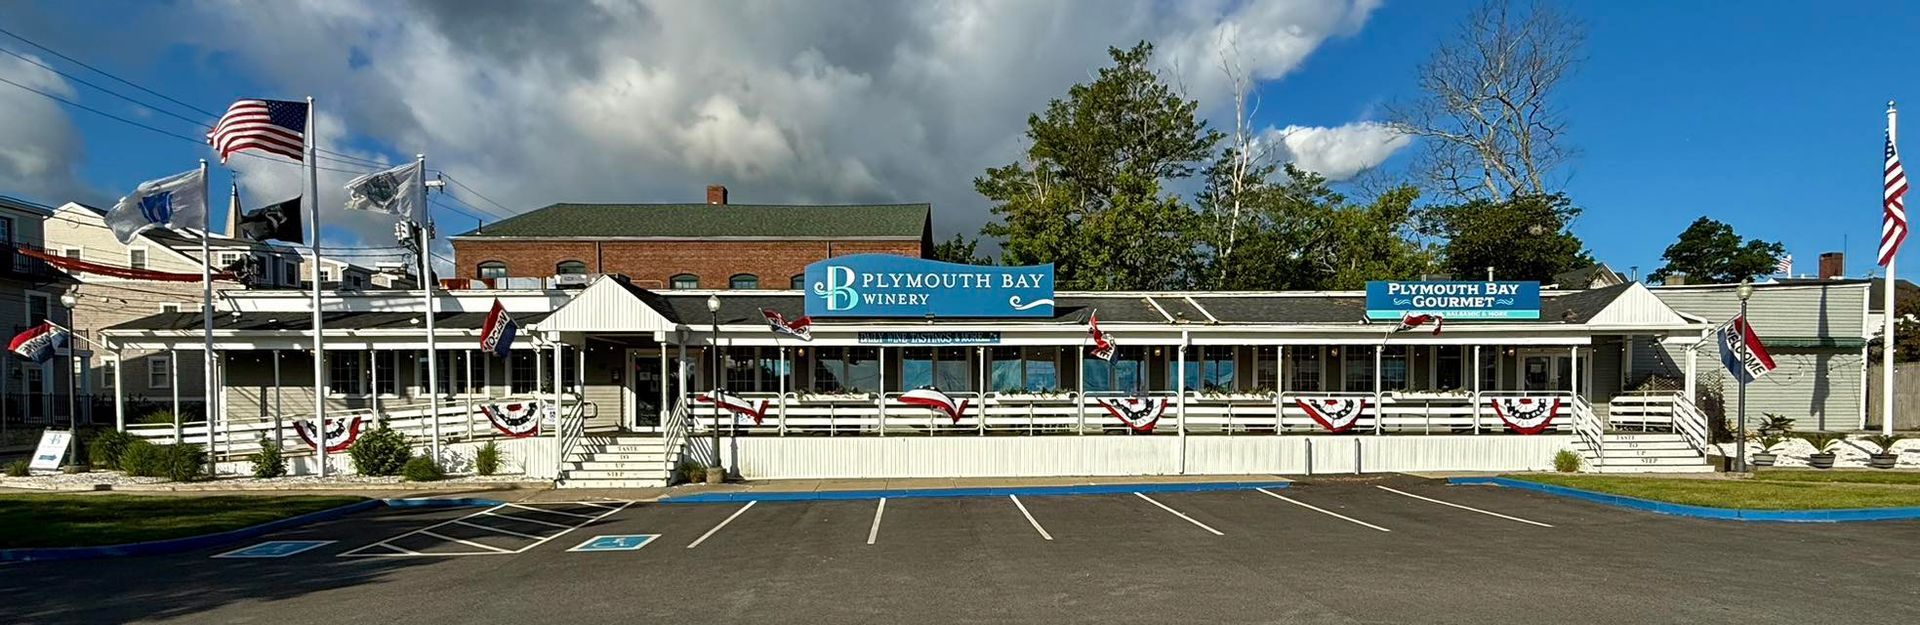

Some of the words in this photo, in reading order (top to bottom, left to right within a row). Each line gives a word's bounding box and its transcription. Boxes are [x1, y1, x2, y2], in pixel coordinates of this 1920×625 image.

[862, 273, 992, 289] PLYMOUTH
[1001, 273, 1045, 289] BAY
[1387, 282, 1479, 295] PLYMOUTH
[1485, 282, 1520, 295] BAY
[862, 293, 931, 305] WINERY
[1412, 295, 1496, 308] GOURMET
[887, 332, 908, 343] WINE
[911, 332, 952, 343] TASTINGS
